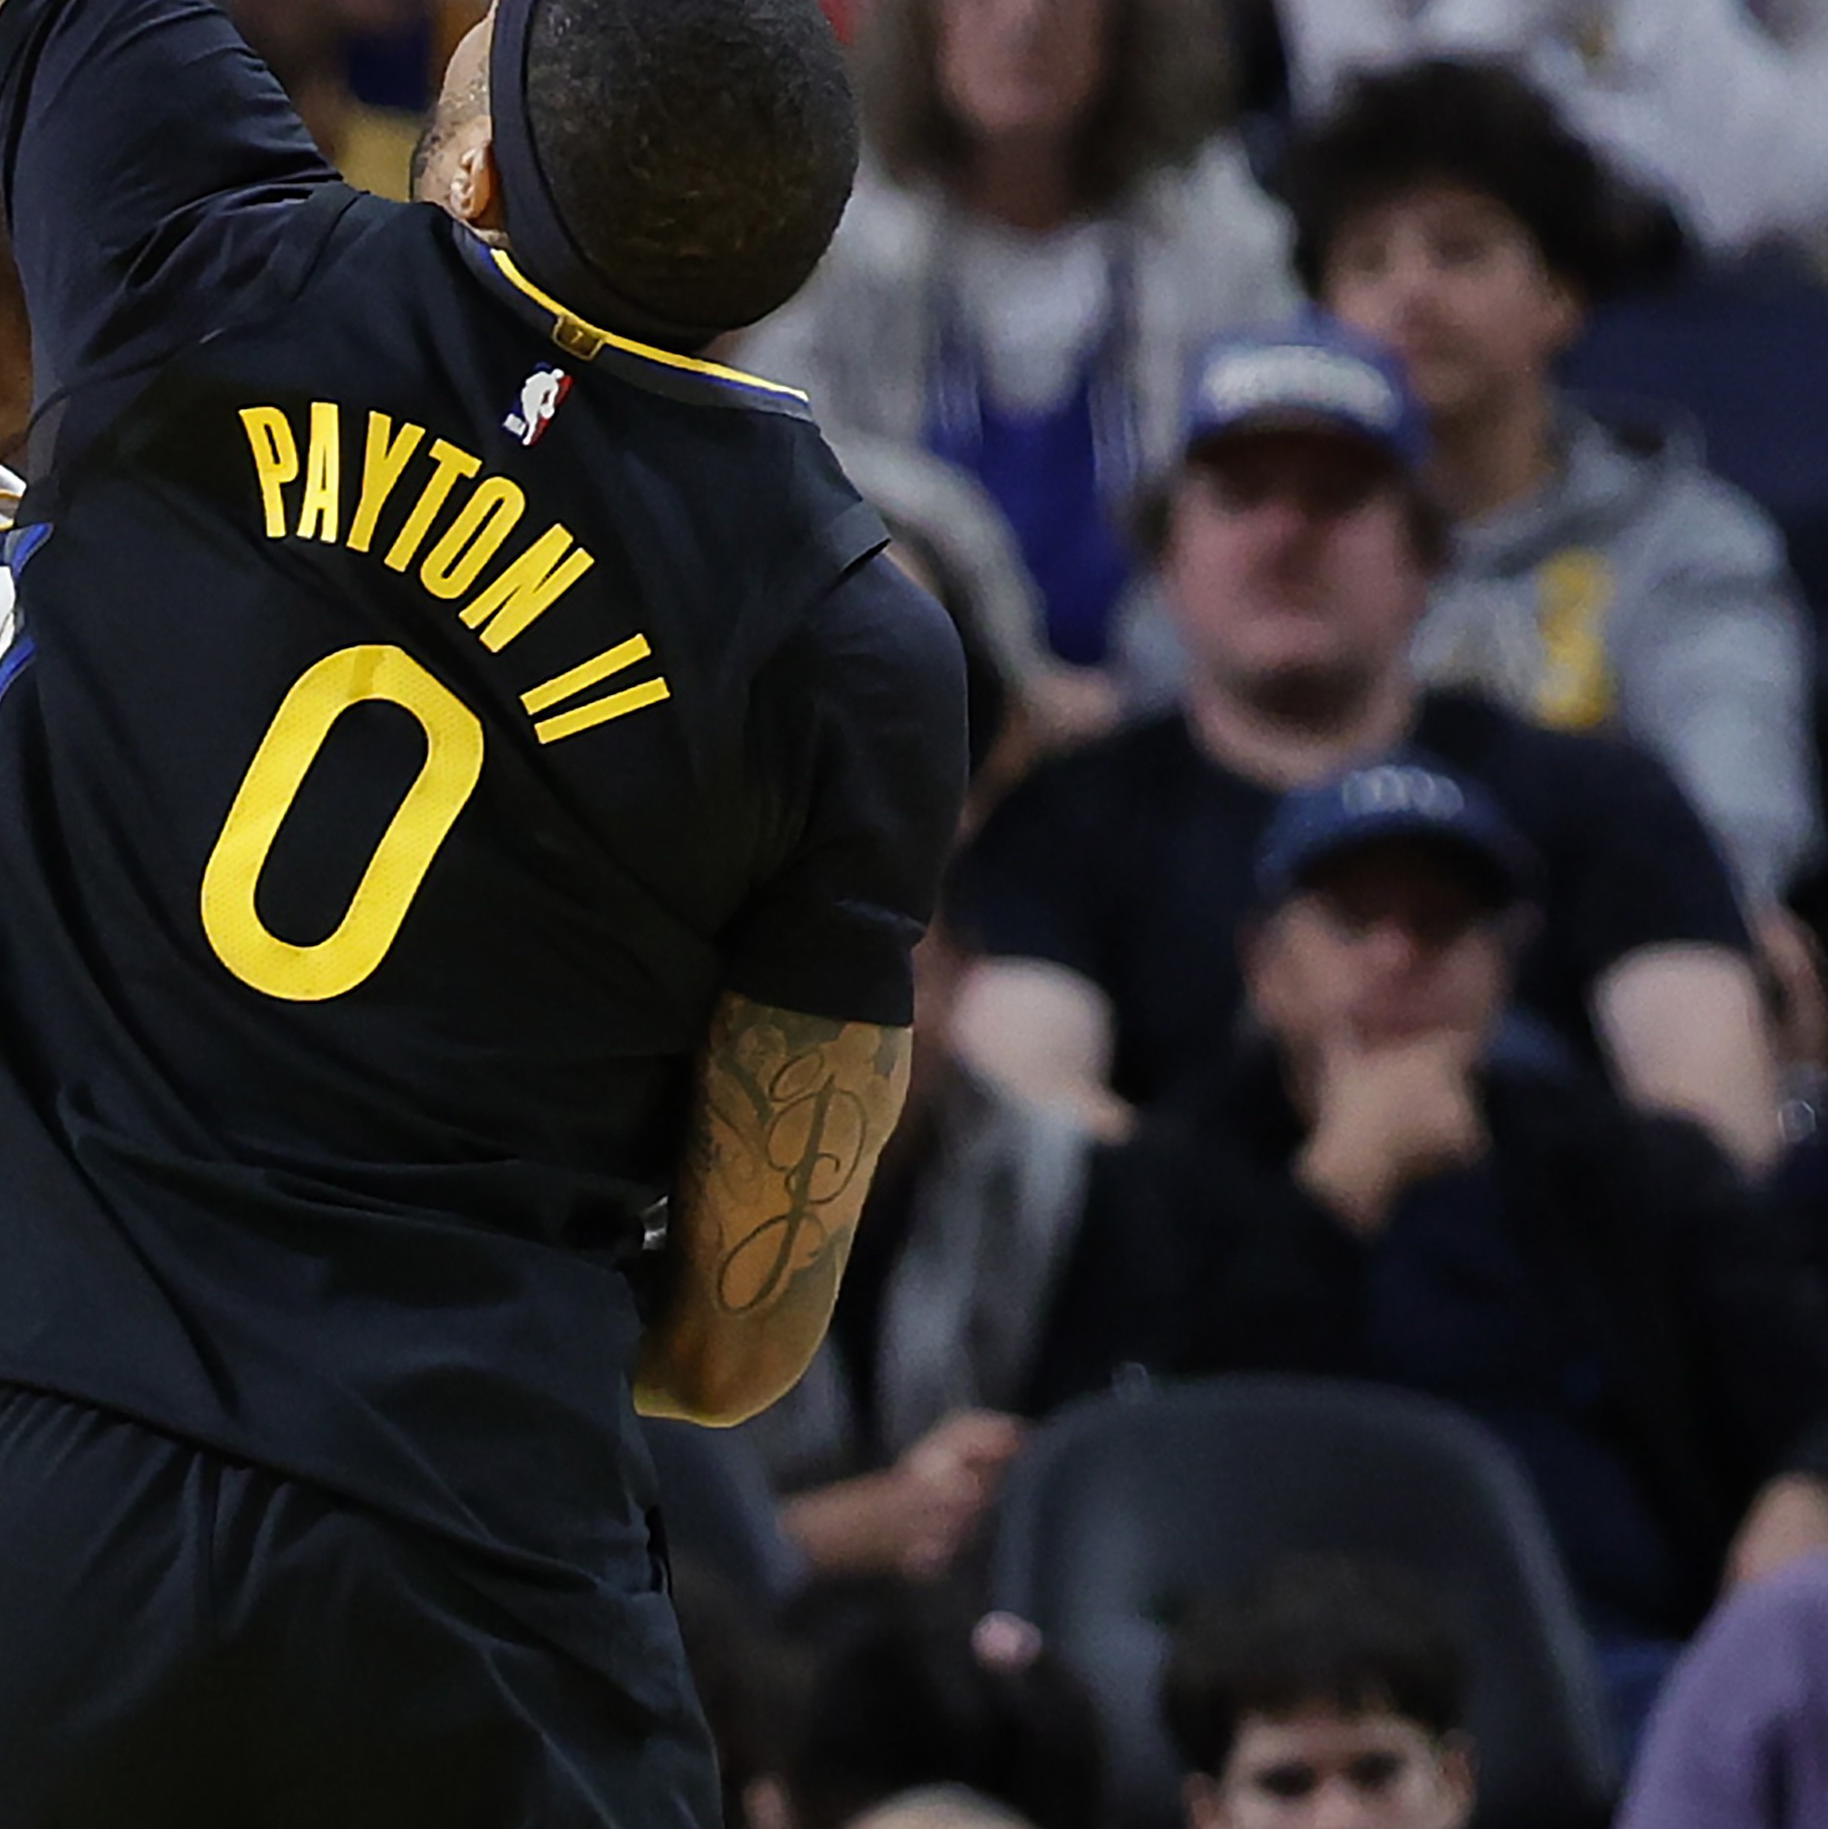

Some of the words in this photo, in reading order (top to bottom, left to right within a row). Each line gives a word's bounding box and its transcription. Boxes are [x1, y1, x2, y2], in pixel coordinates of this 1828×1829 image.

[238, 402, 595, 653] PAYTON
[519, 633, 671, 744] II
[200, 644, 485, 1001] 0
